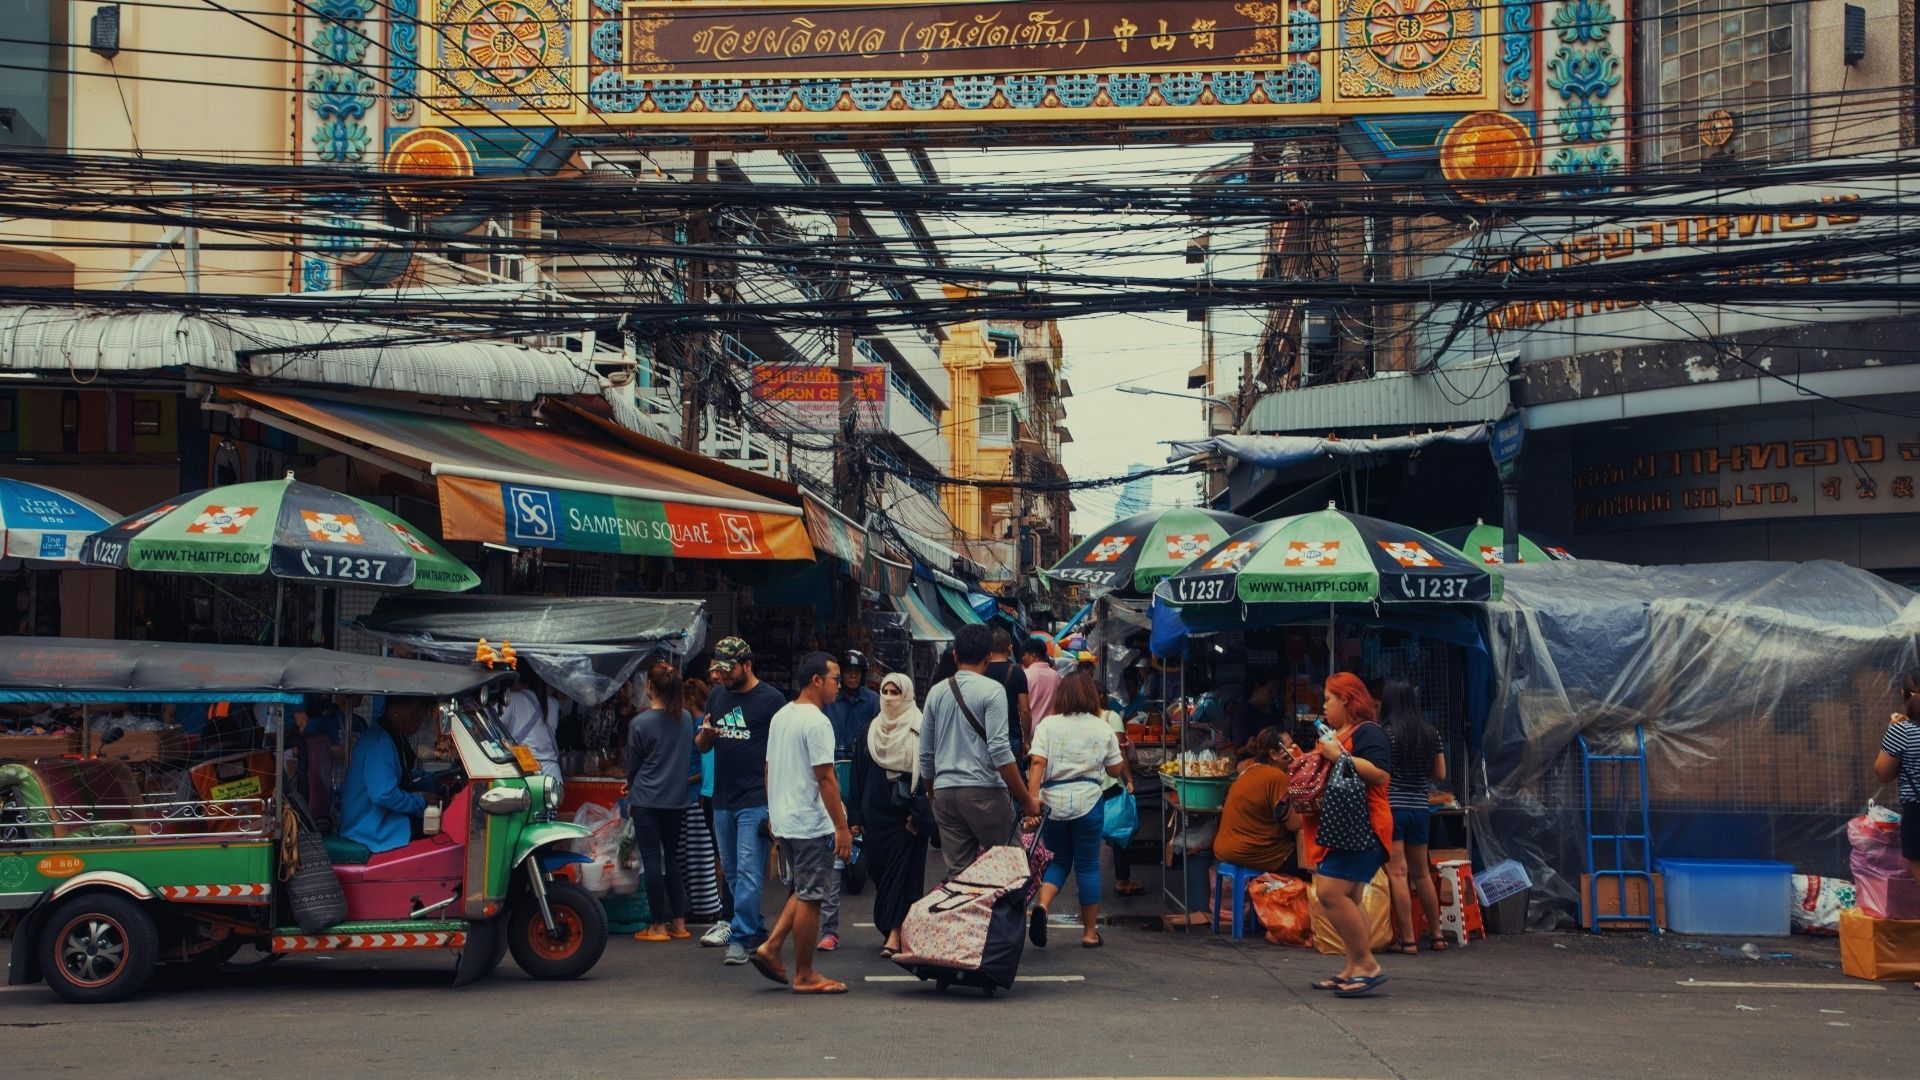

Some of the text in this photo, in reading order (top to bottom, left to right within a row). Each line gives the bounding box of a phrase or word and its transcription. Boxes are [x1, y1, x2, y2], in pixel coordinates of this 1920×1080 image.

[569, 508, 713, 547] SAMPENG SQUARE
[99, 541, 122, 564] 1237
[140, 549, 261, 565] WWW.THAITPI.COM
[323, 557, 388, 581] 1237
[1069, 569, 1116, 585] 1237
[1190, 580, 1224, 600] 1237
[1248, 581, 1369, 594] WWW.THAITPI.COM
[1418, 578, 1468, 598] 1237
